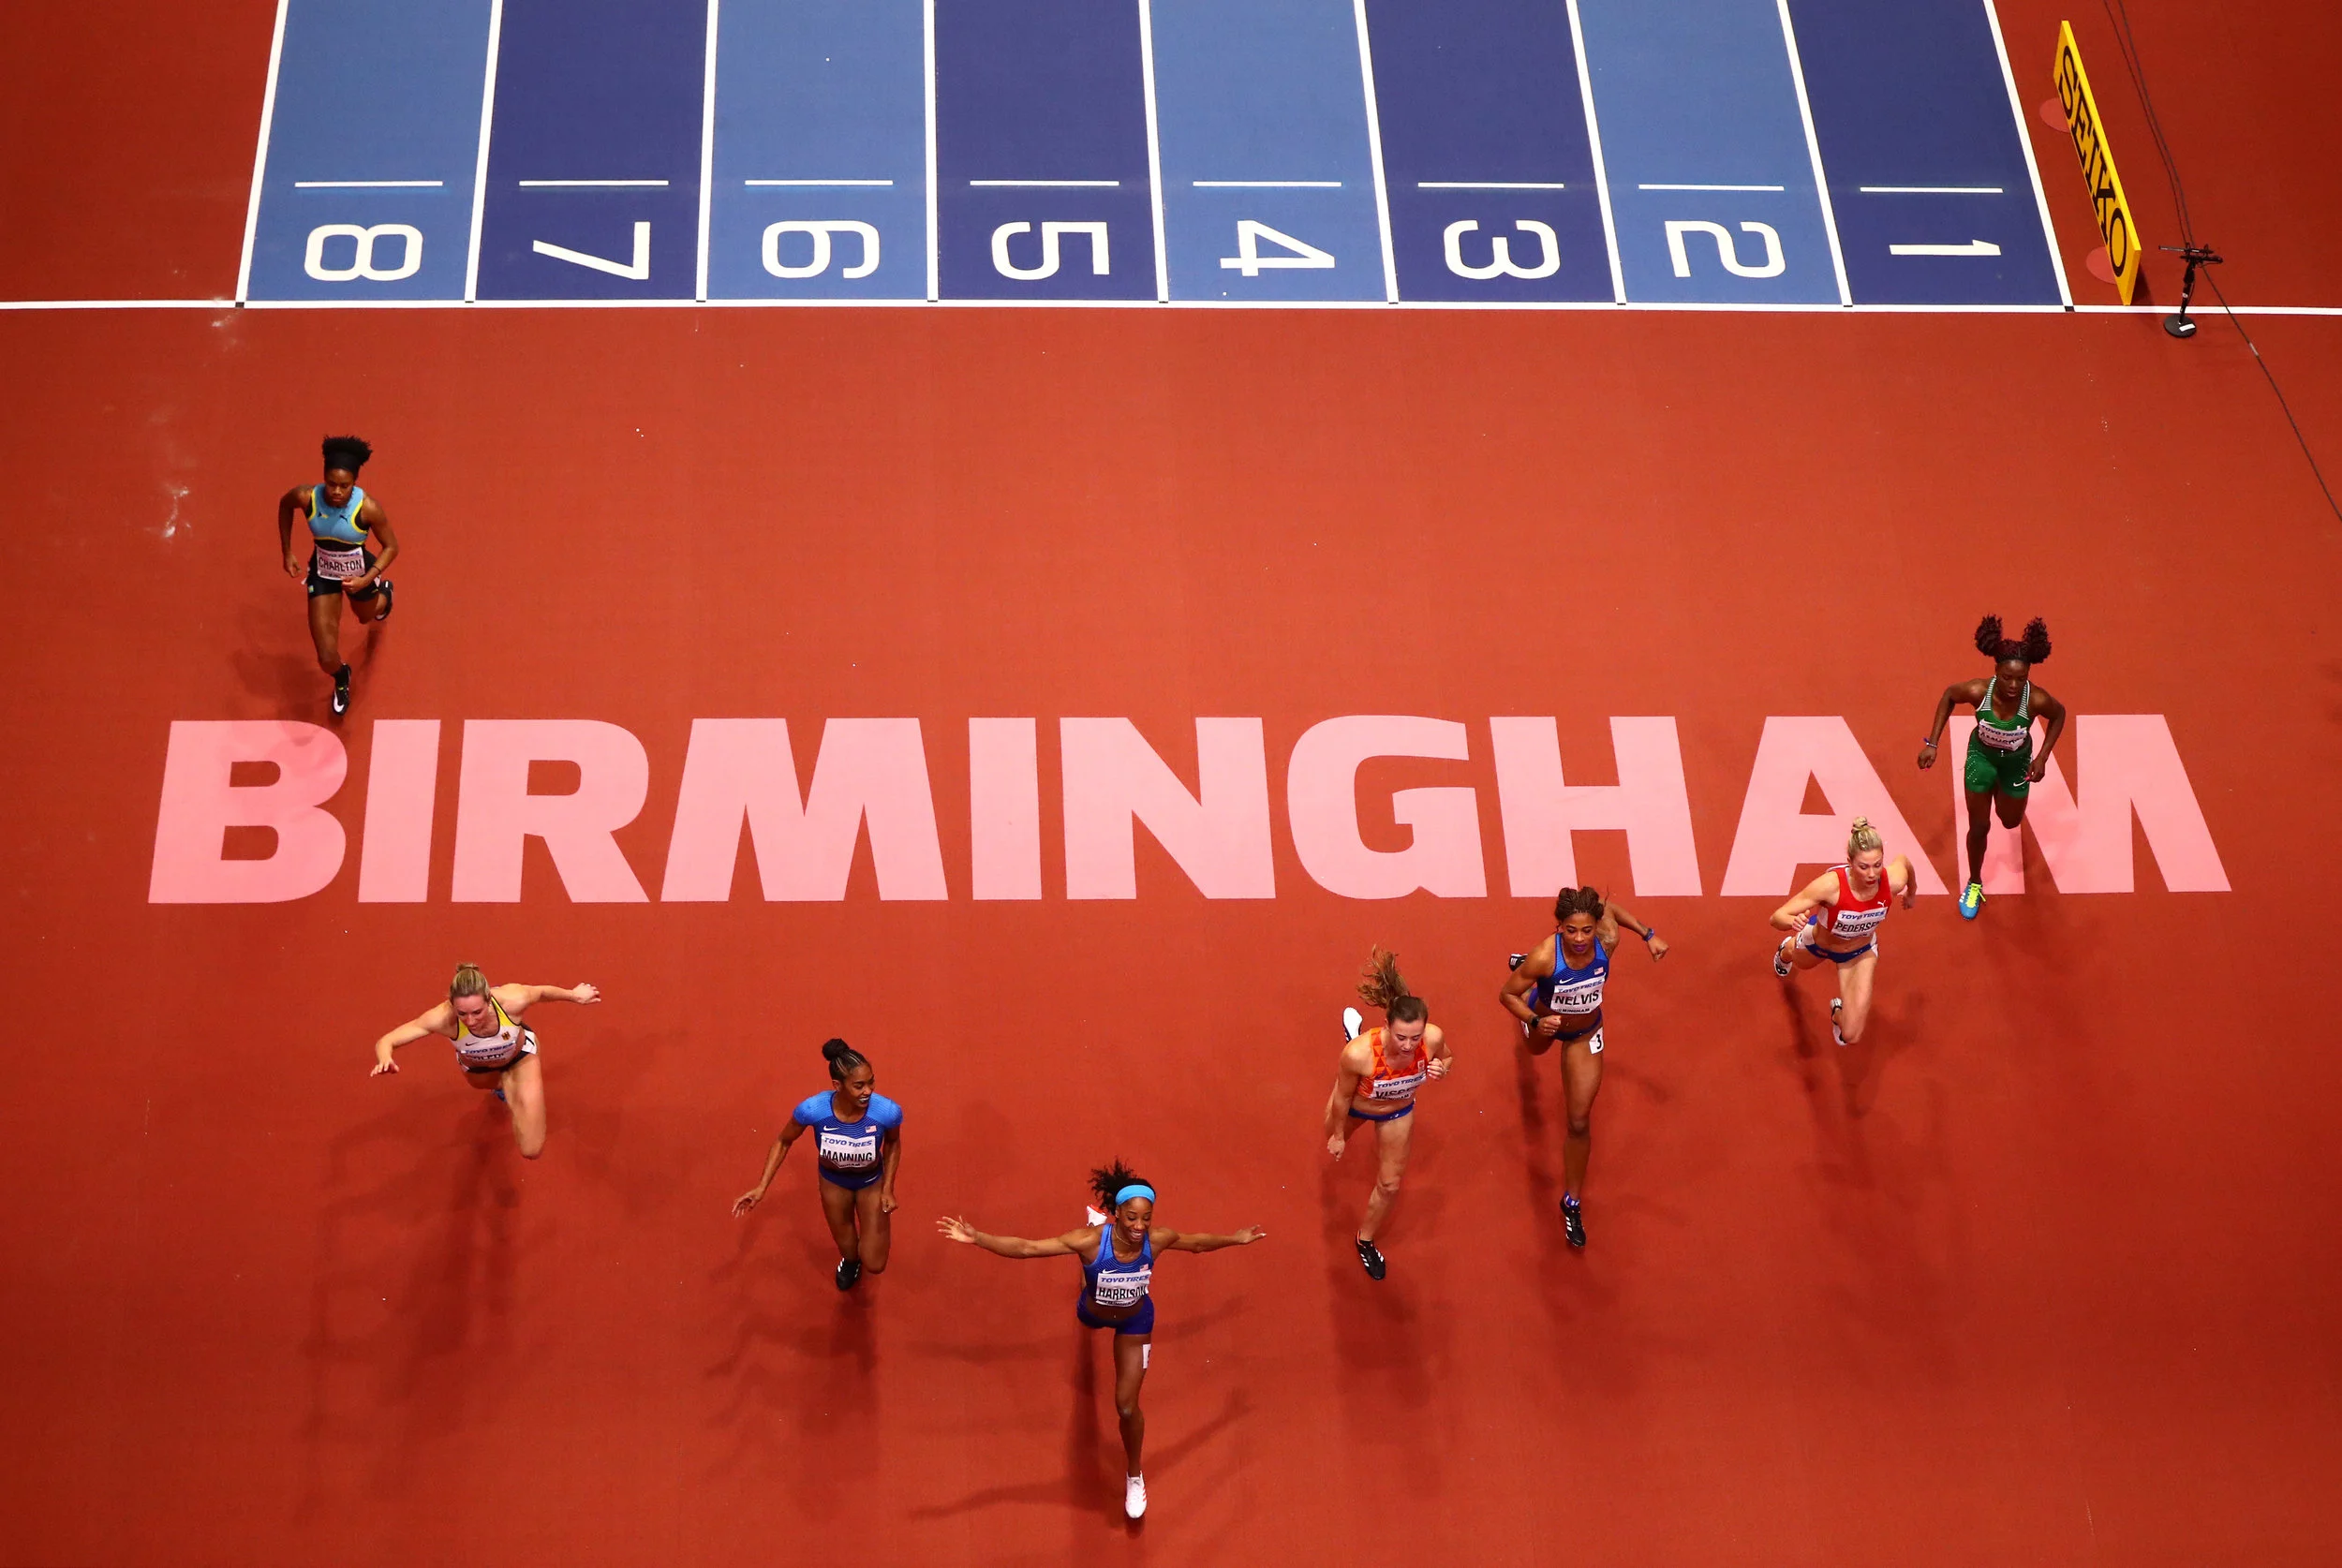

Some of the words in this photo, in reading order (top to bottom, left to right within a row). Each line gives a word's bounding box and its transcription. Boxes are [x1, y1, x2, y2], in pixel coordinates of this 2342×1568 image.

[2058, 45, 2127, 278] SEIKO
[303, 223, 423, 282] 8
[532, 220, 650, 280] 7
[761, 220, 881, 280] 6
[990, 221, 1111, 280] 5
[1219, 219, 1337, 279] 4
[1443, 219, 1563, 280] 3
[1665, 220, 1786, 280] 2
[1889, 240, 2002, 259] 1
[318, 556, 363, 572] CHARLTON
[148, 713, 2232, 906] BIRMINGHAM
[1863, 910, 1885, 918] TIRES
[1580, 979, 1604, 989] TIRES
[1554, 989, 1600, 1006] NELVIS
[1595, 1033, 1602, 1050] 3
[1377, 1080, 1400, 1088] TOYO
[1401, 1073, 1427, 1086] TIRES
[824, 1136, 847, 1146] TOYO
[848, 1140, 872, 1148] TIRES
[823, 1148, 873, 1162] MANNING
[1126, 1274, 1149, 1282] TIRES
